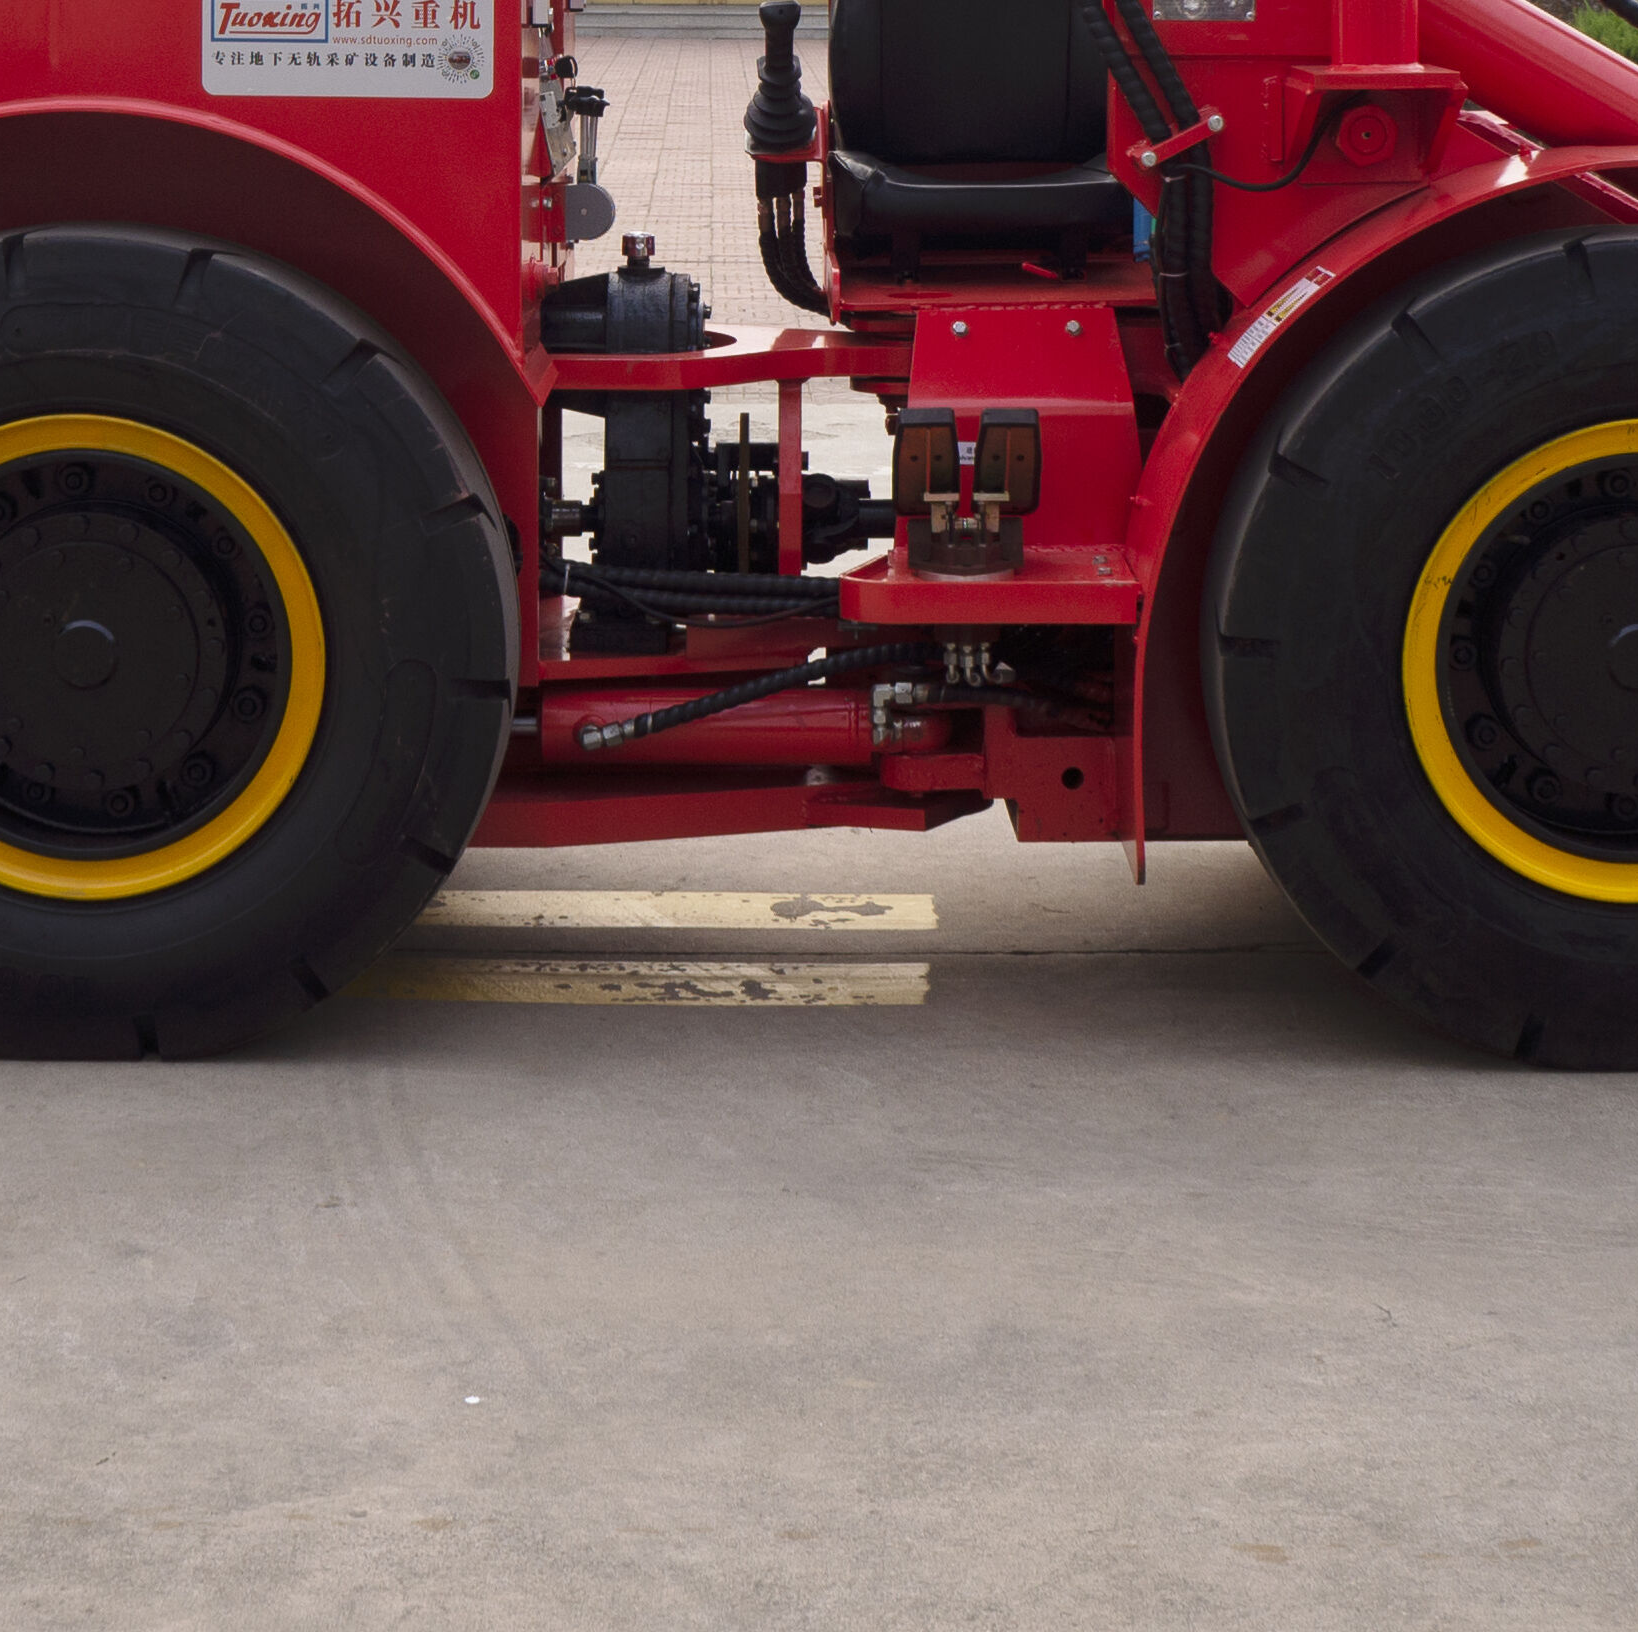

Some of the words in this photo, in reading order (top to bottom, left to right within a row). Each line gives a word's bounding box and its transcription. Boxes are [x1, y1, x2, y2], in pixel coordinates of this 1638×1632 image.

[218, 2, 322, 35] Tuoxing
[332, 35, 438, 47] www.sdtuoxing.com
[213, 50, 436, 68] 专注地下无轨采矿设备制造
